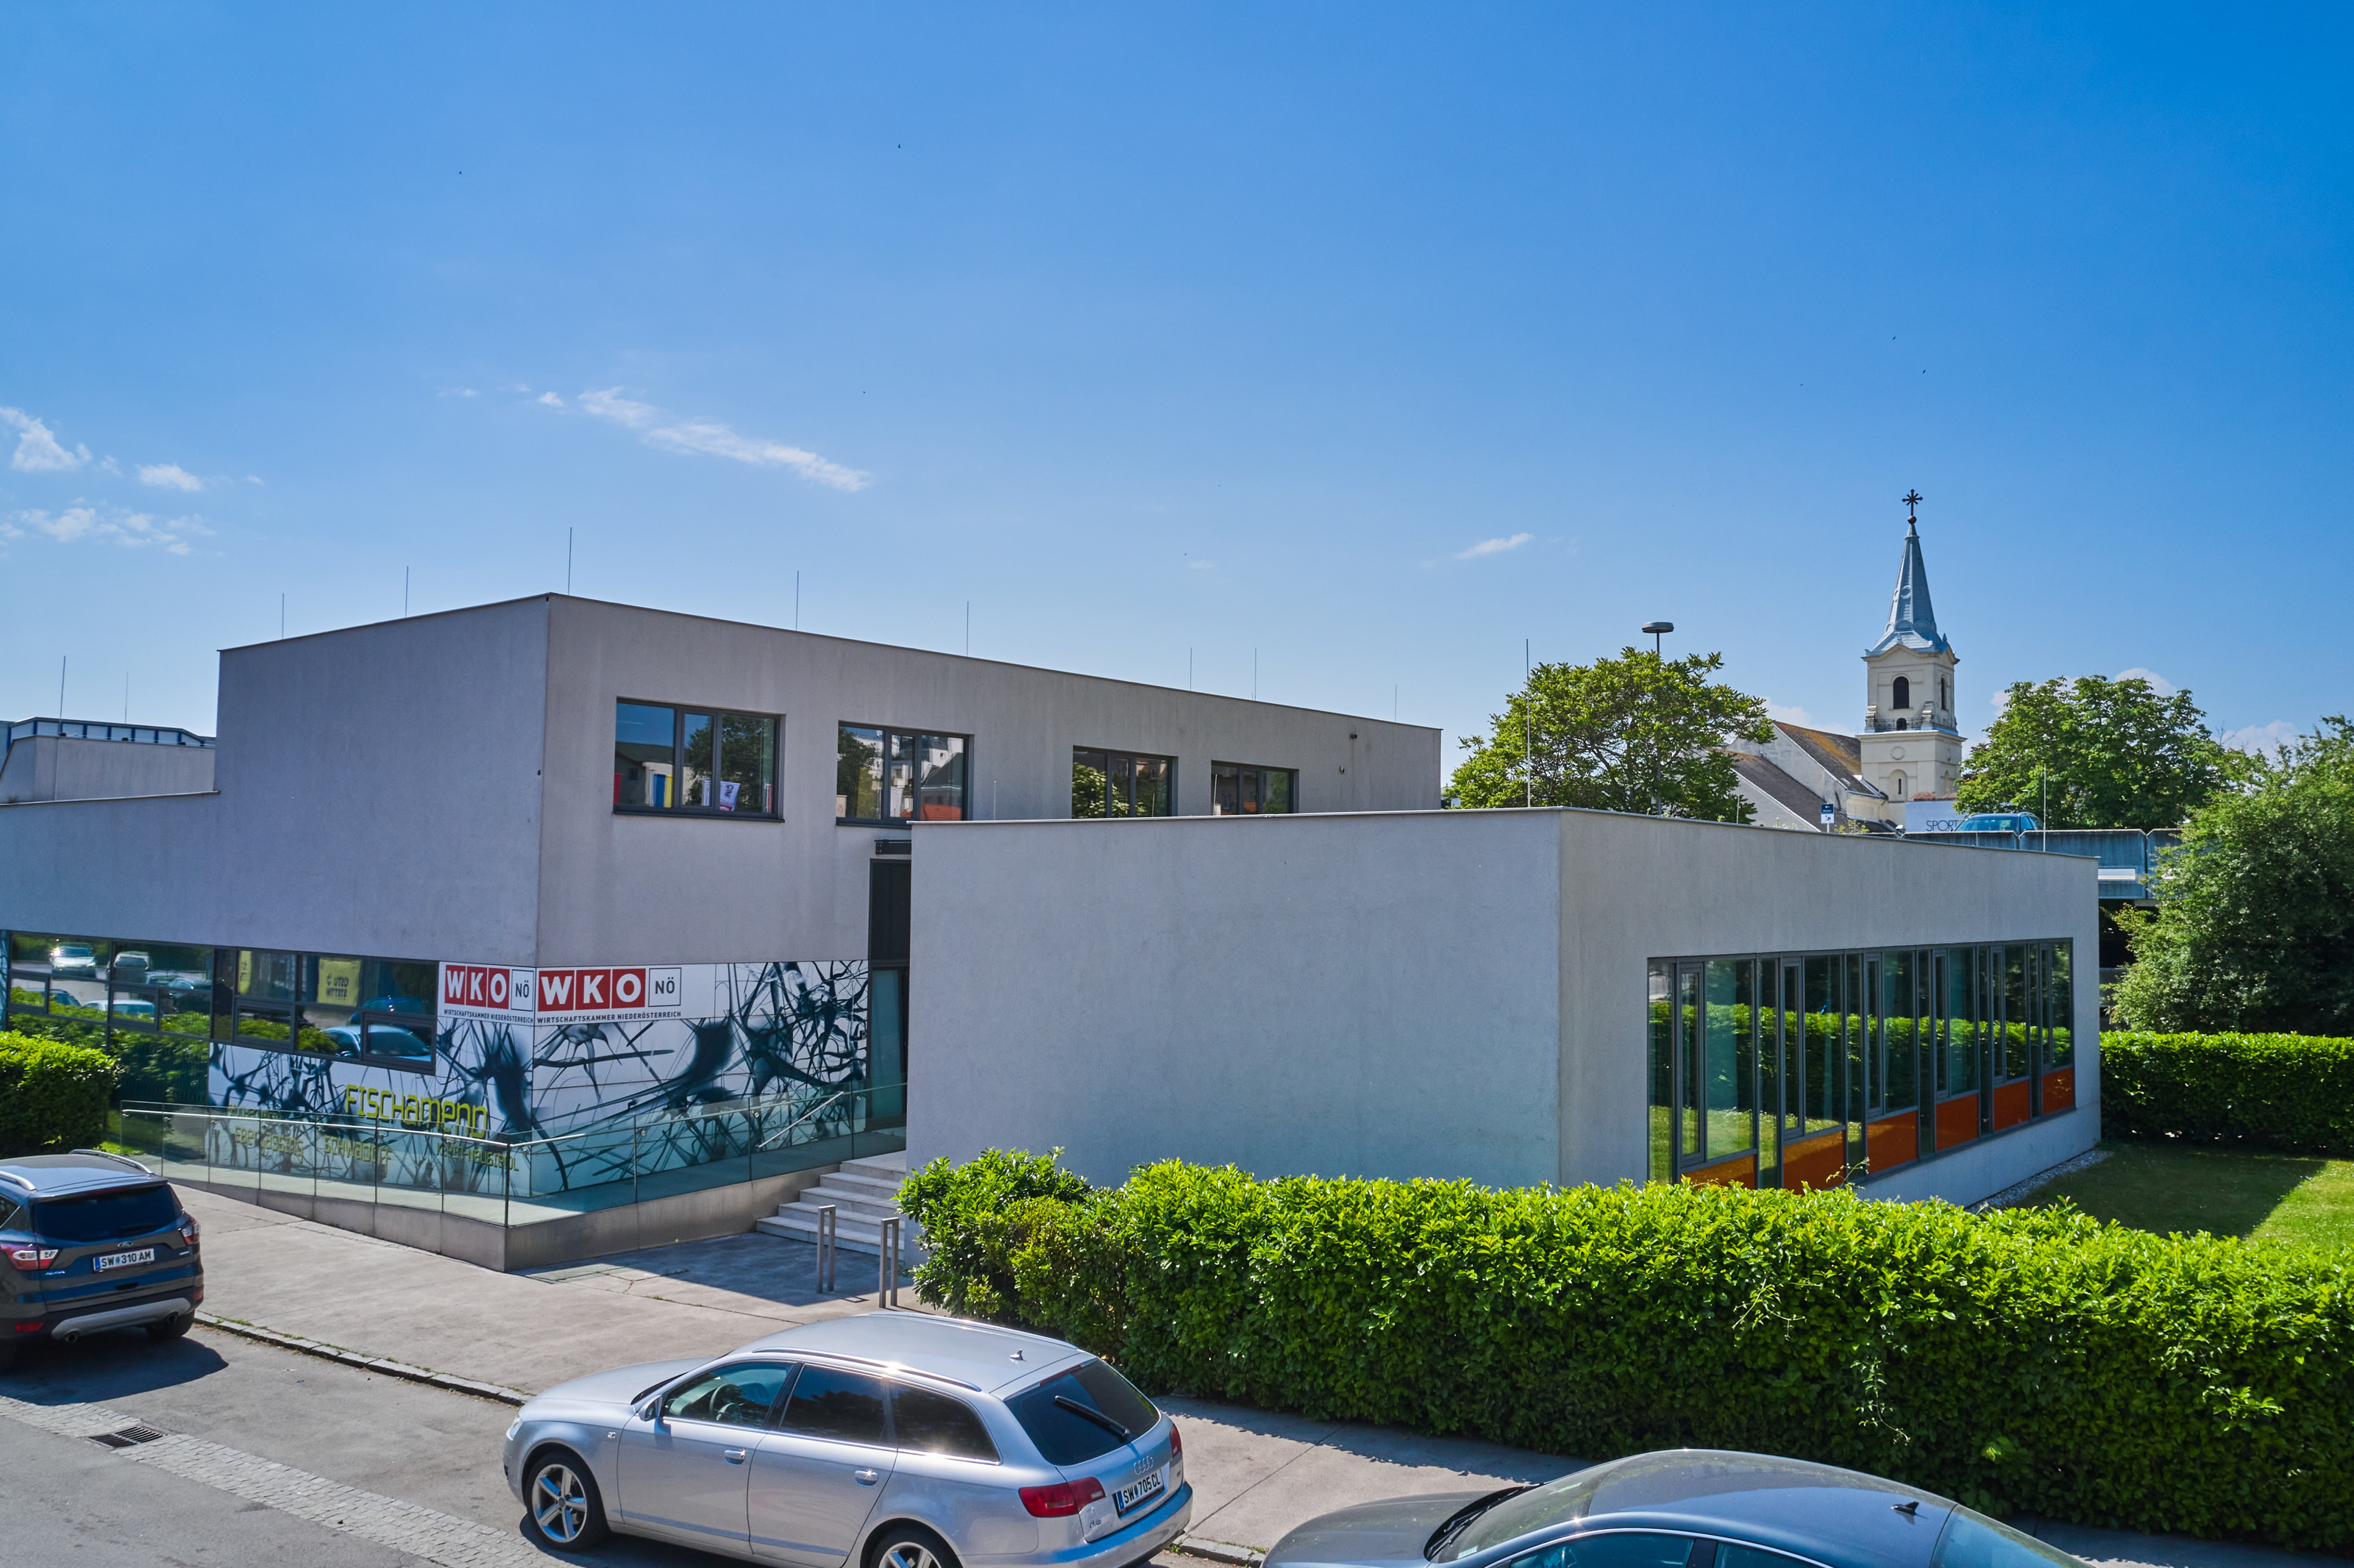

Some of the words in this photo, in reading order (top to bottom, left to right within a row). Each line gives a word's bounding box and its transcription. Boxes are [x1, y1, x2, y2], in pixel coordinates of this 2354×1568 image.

[1926, 819, 1960, 832] SPORT
[447, 970, 507, 1003] WKO
[515, 980, 530, 998] NÖ
[541, 973, 641, 1005] WKO
[655, 977, 675, 994] NÖ
[444, 1009, 490, 1020] WIRTSCHAFTSKAMMER
[491, 1013, 533, 1024] NIEDERÖSTERREICH
[537, 1013, 615, 1024] WIRTSCHAFTSKAMMER
[617, 1011, 681, 1020] NIEDERÖSTERREICH
[101, 1257, 114, 1267] SW
[121, 1252, 137, 1264] 310
[139, 1250, 152, 1261] AM
[1123, 1486, 1134, 1504] SW
[1138, 1476, 1152, 1495] 705
[1151, 1472, 1161, 1490] CL
